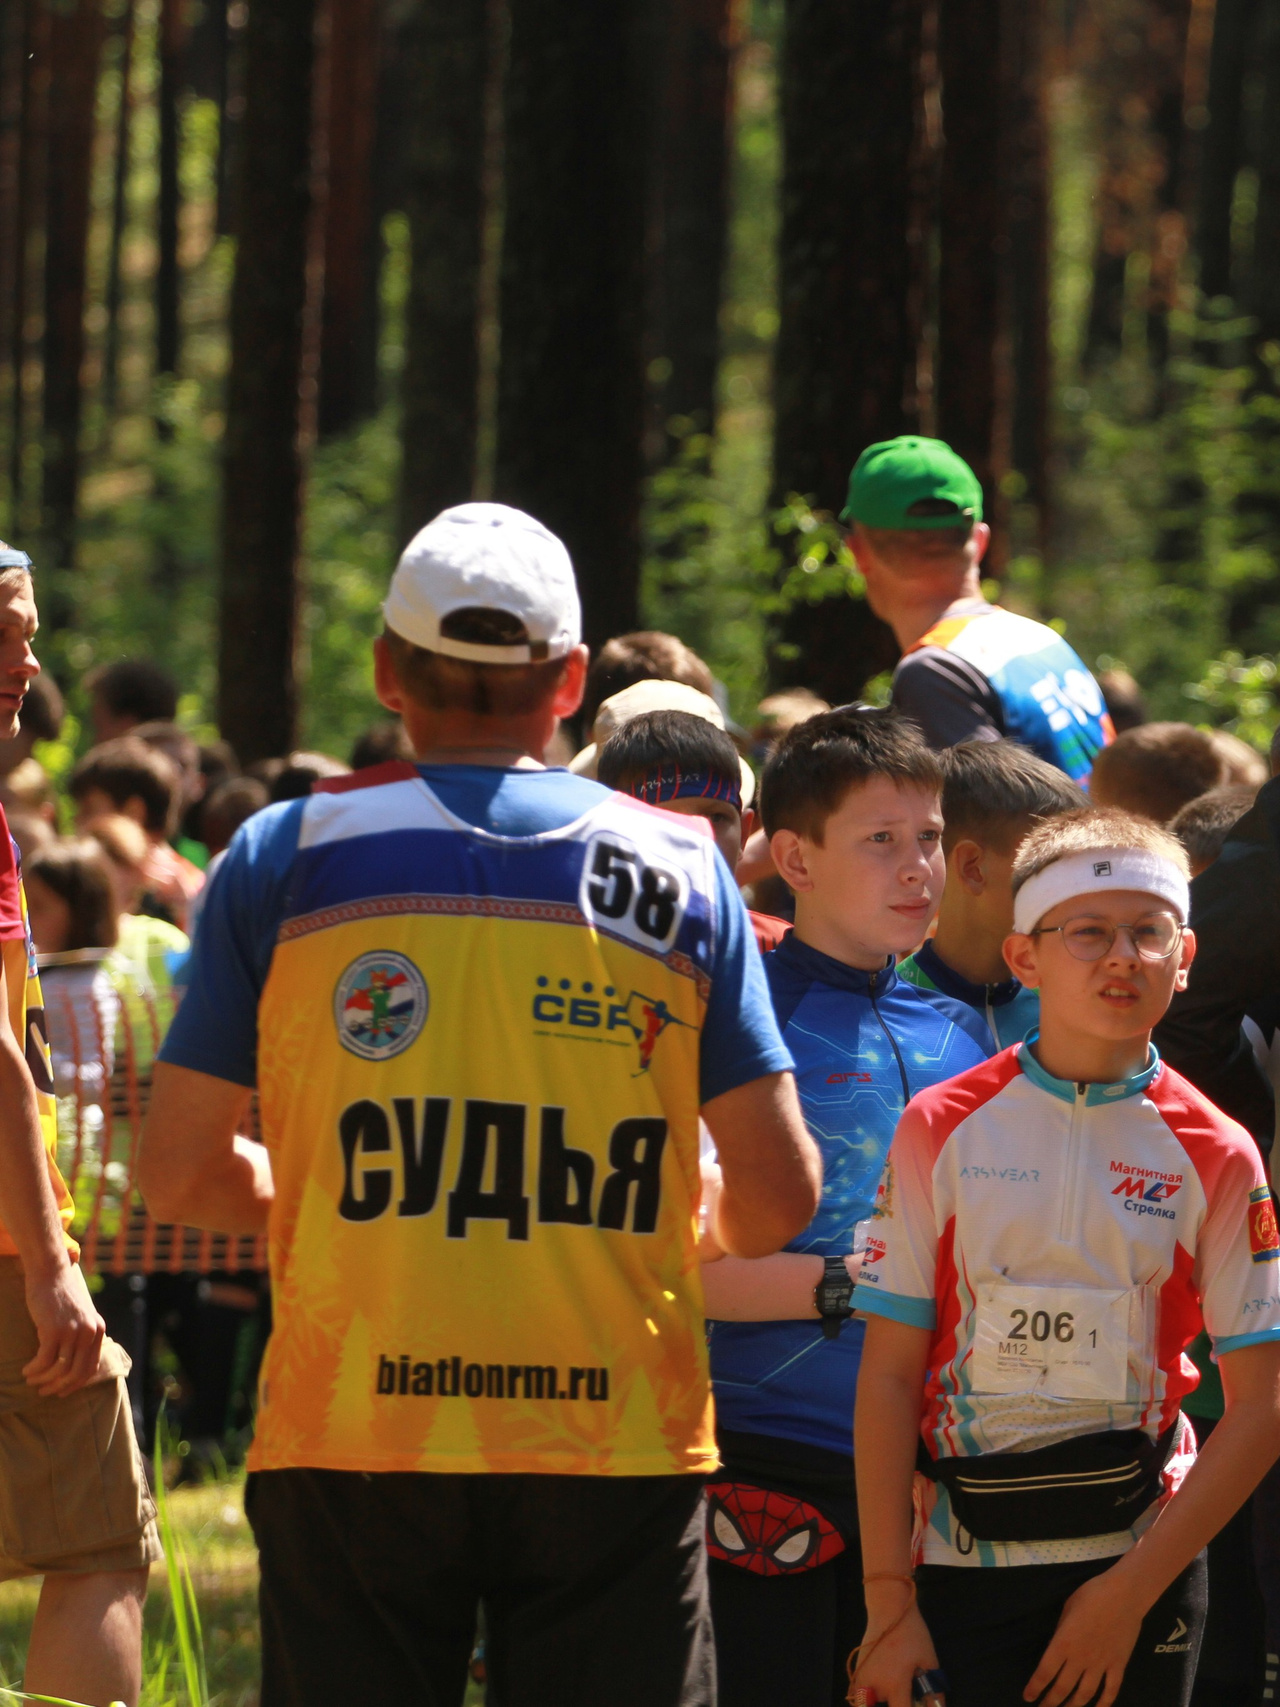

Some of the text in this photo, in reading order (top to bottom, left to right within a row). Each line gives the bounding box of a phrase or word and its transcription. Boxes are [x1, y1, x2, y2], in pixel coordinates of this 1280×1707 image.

[588, 841, 681, 941] 58
[338, 1097, 668, 1242] СУДЬЯ
[1109, 1160, 1184, 1184] Магнитная
[1123, 1199, 1177, 1221] Стрелка
[1007, 1309, 1098, 1349] 206 1
[376, 1354, 609, 1402] biatlonrm.ru
[1154, 1642, 1193, 1653] DEMIX
